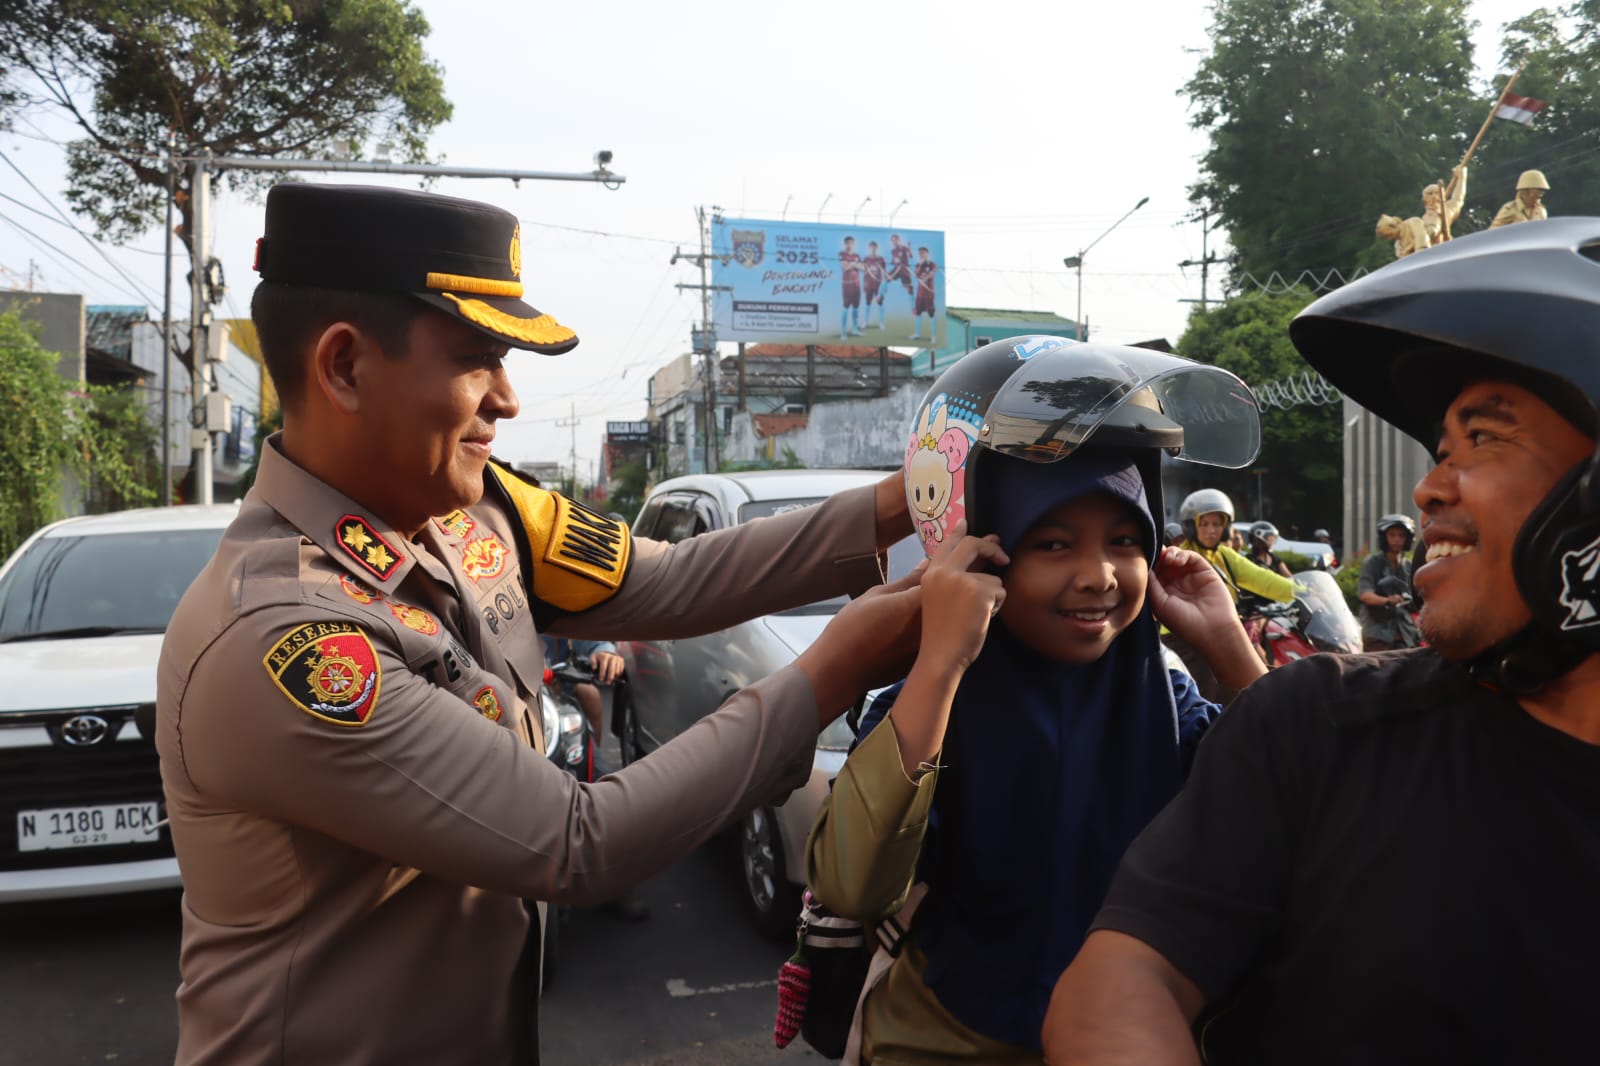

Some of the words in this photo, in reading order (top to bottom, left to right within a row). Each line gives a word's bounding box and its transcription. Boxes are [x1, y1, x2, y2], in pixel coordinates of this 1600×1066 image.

[775, 235, 818, 244] SELAMAT
[775, 250, 819, 264] 2025
[270, 622, 353, 666] RESERSE
[22, 815, 36, 837] N
[50, 810, 104, 835] 1180
[115, 806, 153, 829] ACK
